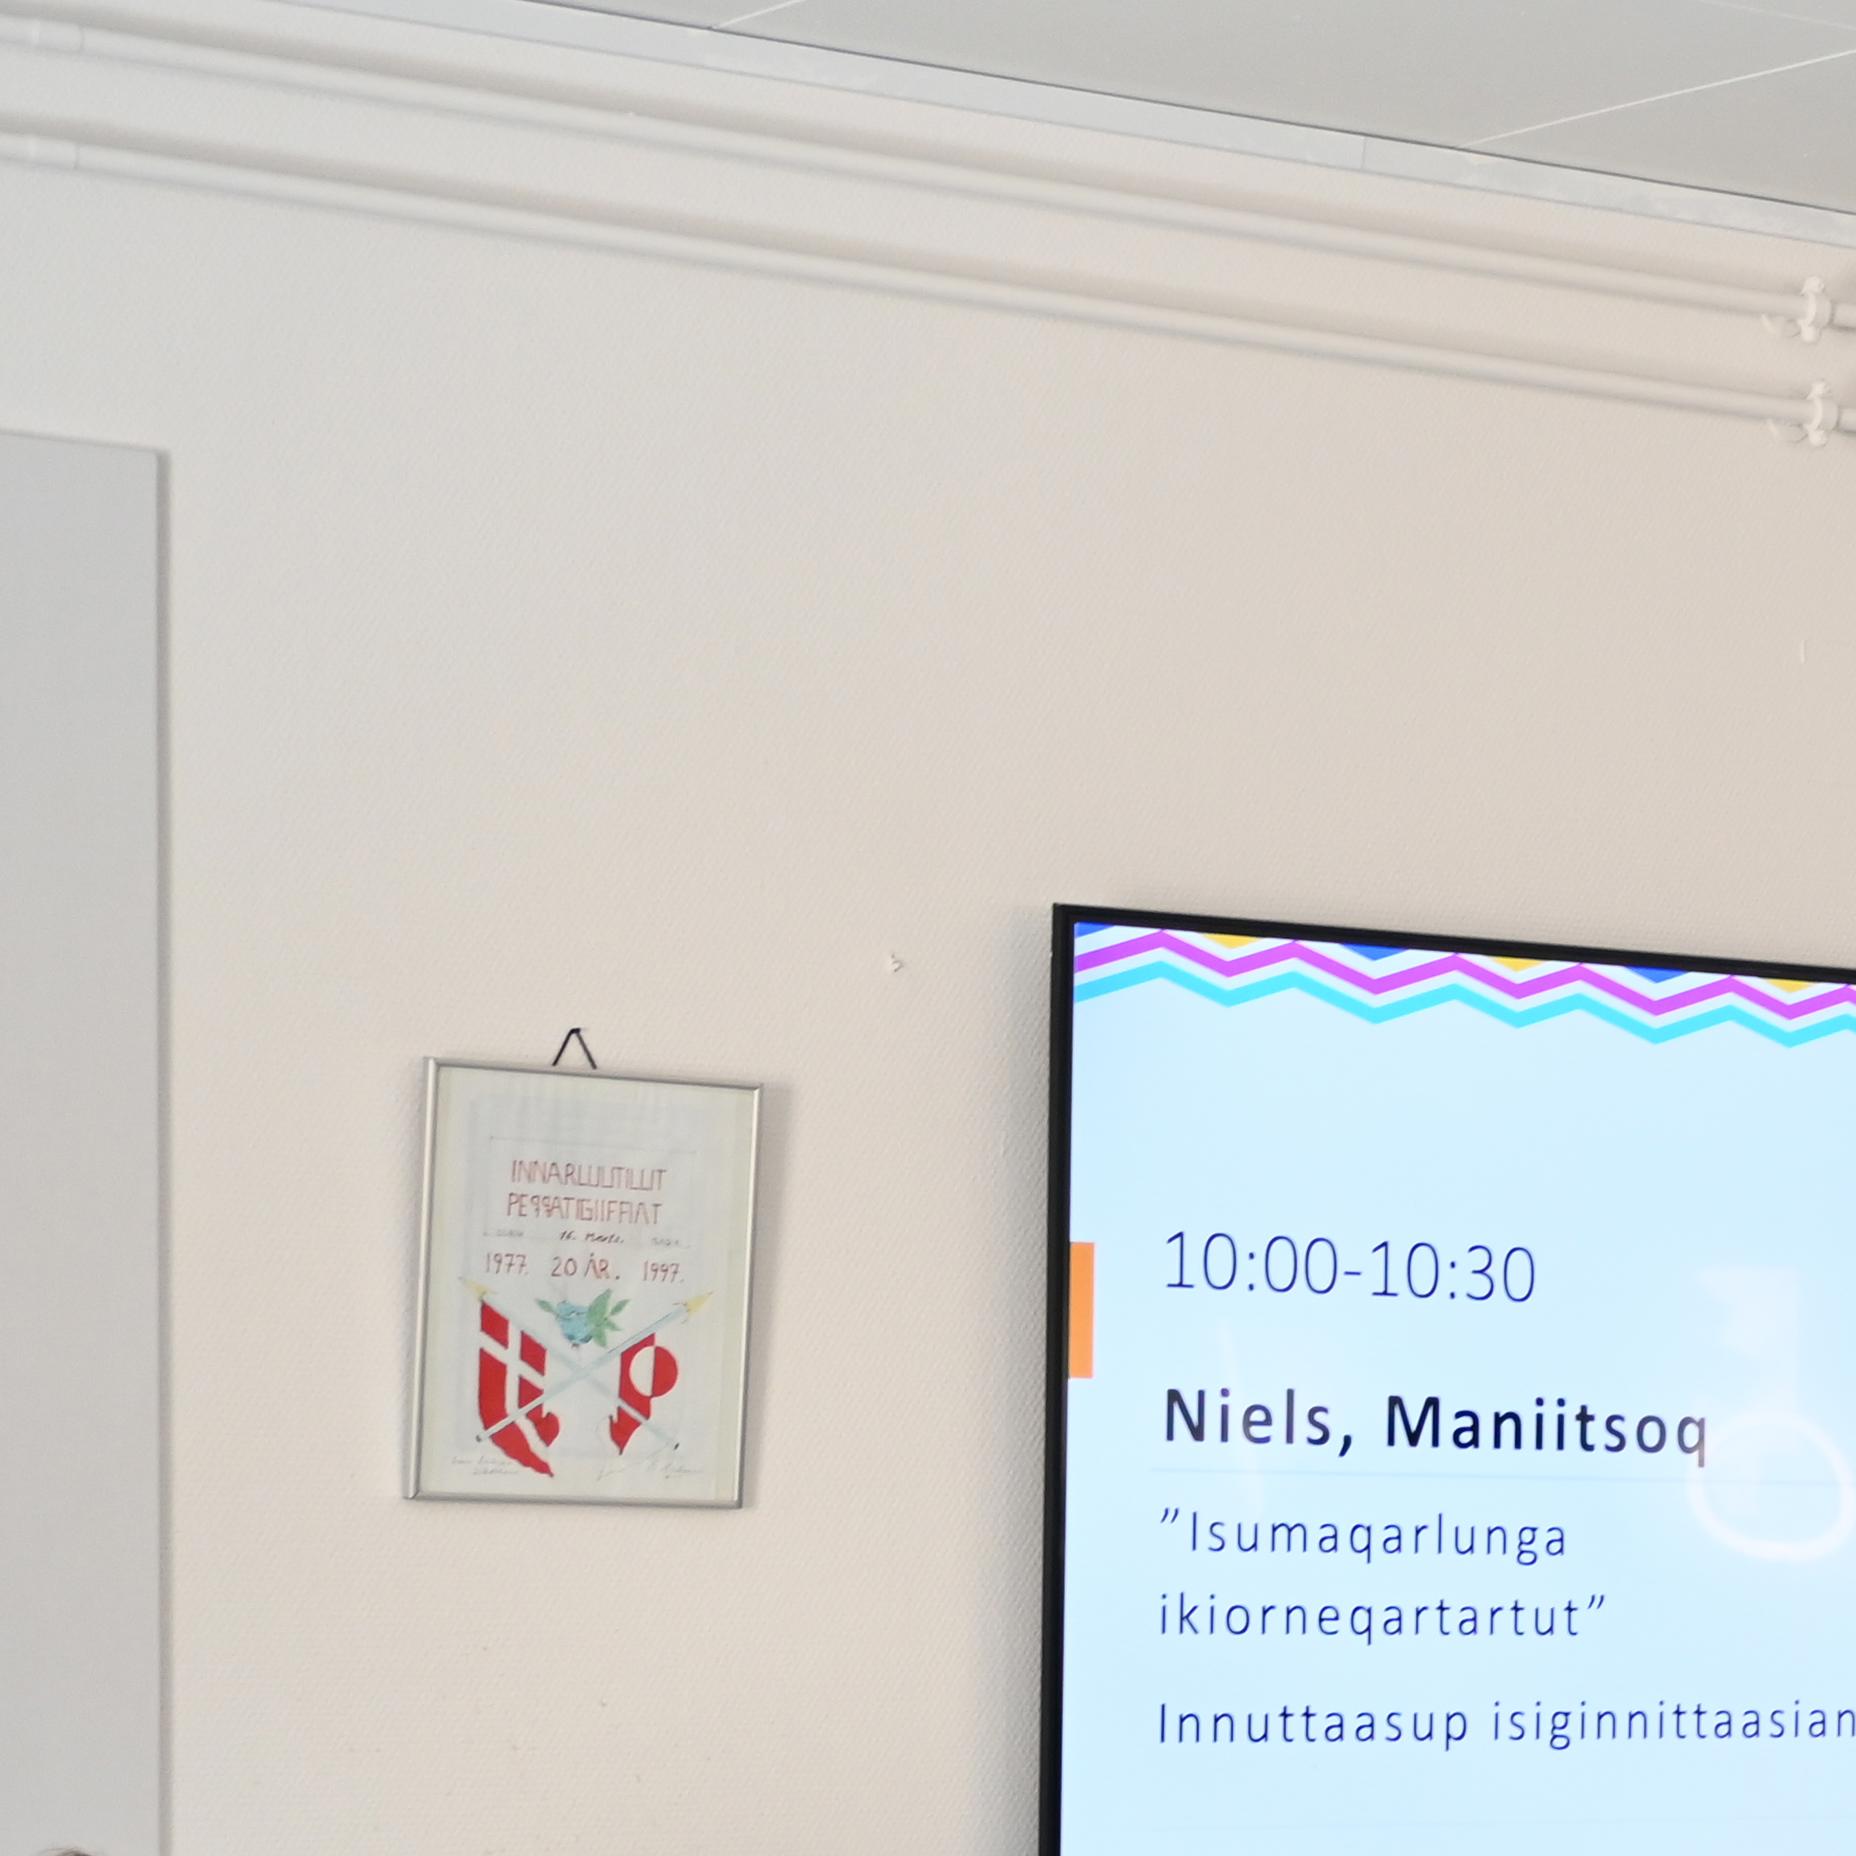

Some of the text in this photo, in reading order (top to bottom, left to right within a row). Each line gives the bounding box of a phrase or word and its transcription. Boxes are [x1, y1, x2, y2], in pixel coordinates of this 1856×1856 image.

[550, 1256, 579, 1278] 20
[1165, 1230, 1536, 1304] 10:00-10:30
[1165, 1387, 1705, 1468] Niels, Maniitsoq
[1159, 1702, 1468, 1753] Innuttaasup
